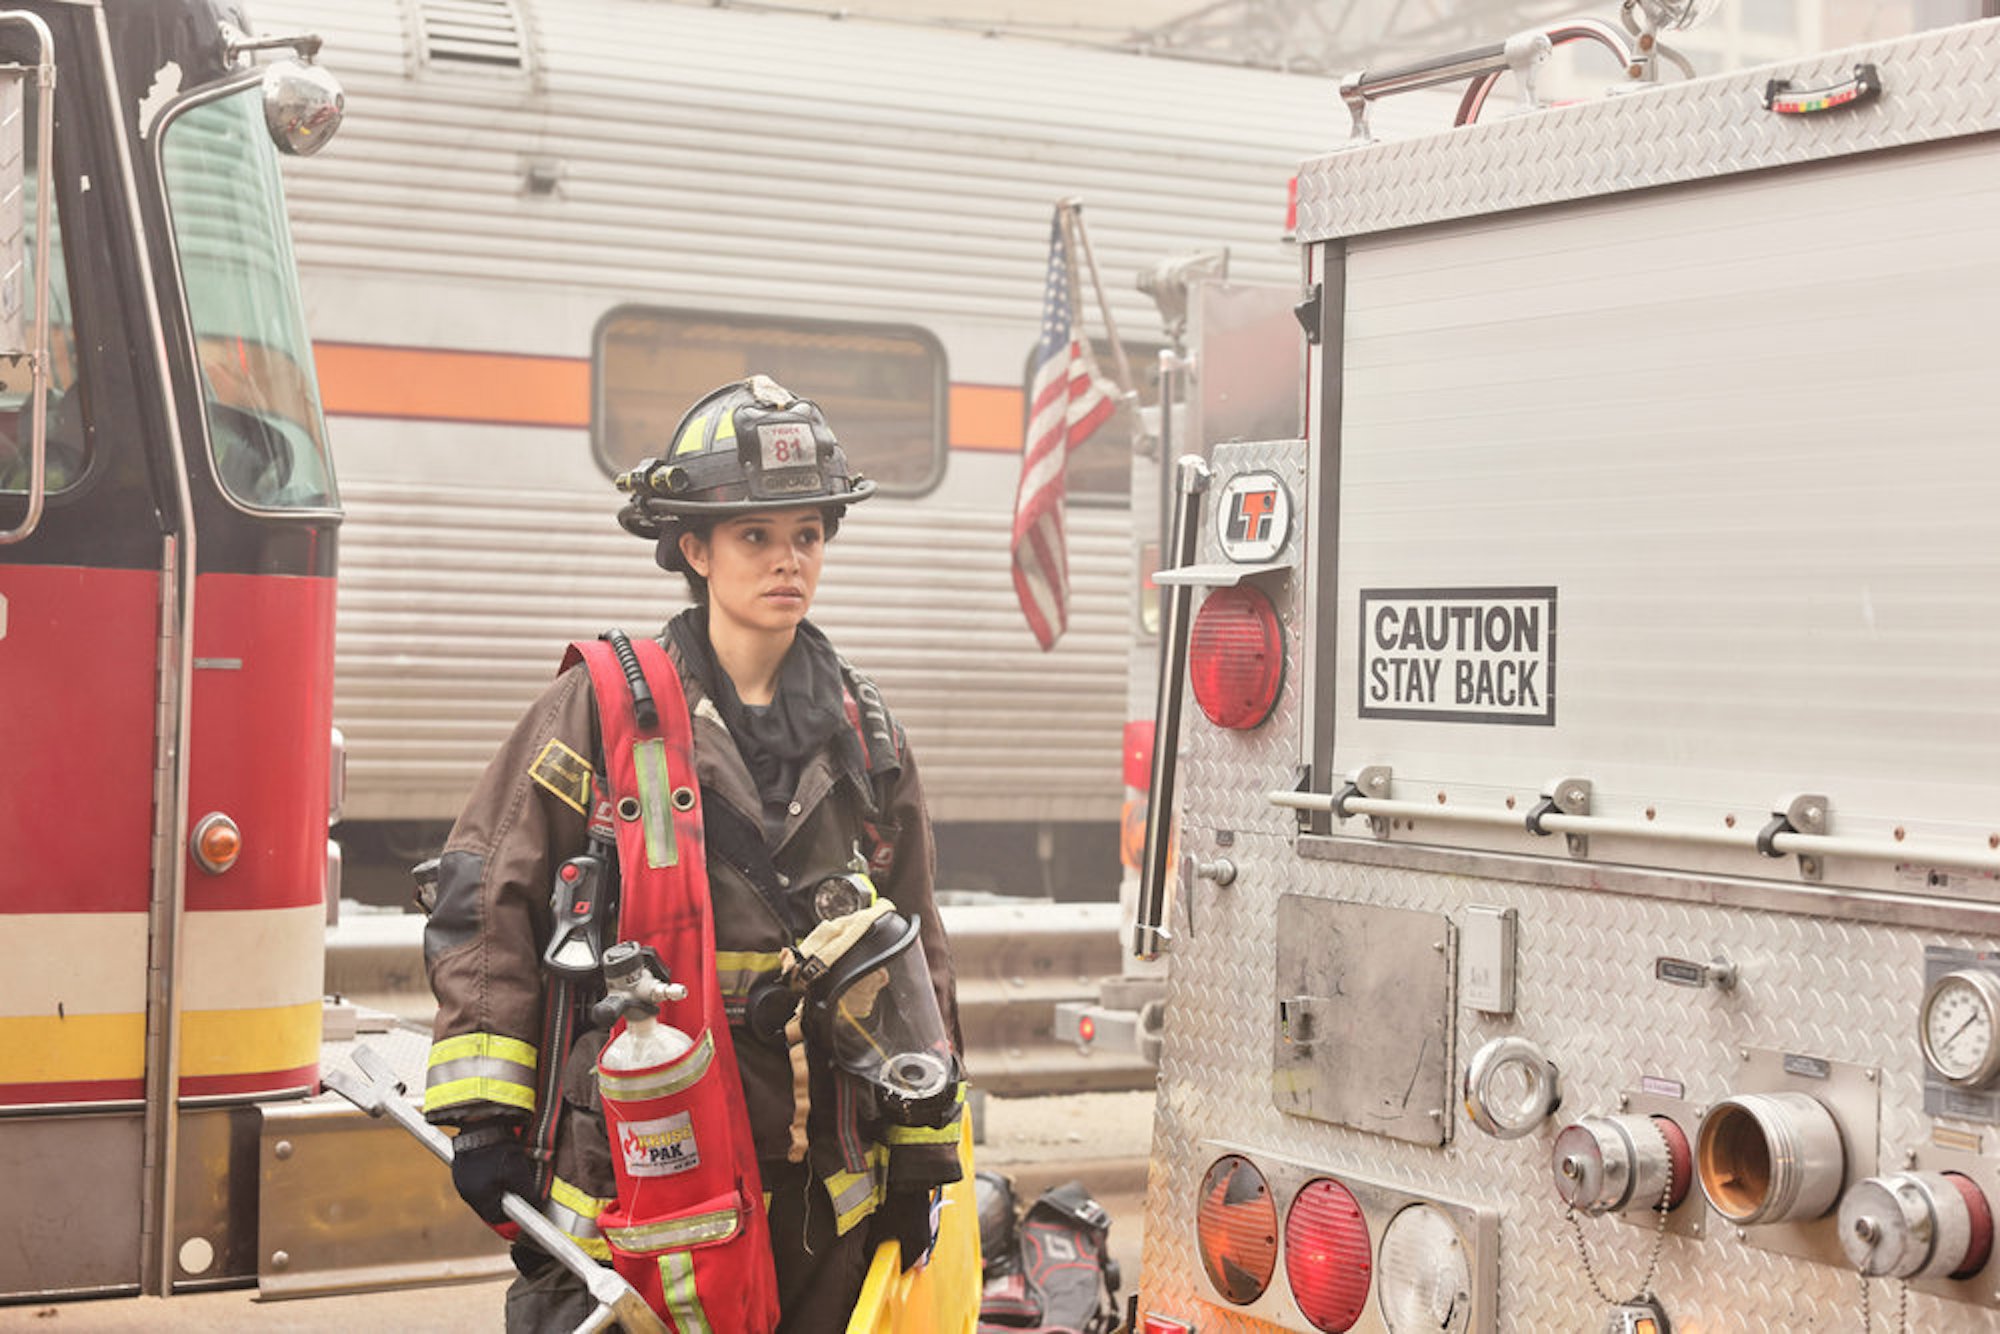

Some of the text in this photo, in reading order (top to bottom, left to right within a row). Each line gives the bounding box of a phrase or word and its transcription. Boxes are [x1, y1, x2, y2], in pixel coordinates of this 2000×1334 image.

[772, 427, 800, 436] TRUCK
[775, 438, 802, 462] 81
[1375, 605, 1539, 652] CAUTION
[1370, 657, 1540, 707] STAY BACK
[649, 1143, 683, 1162] PAK
